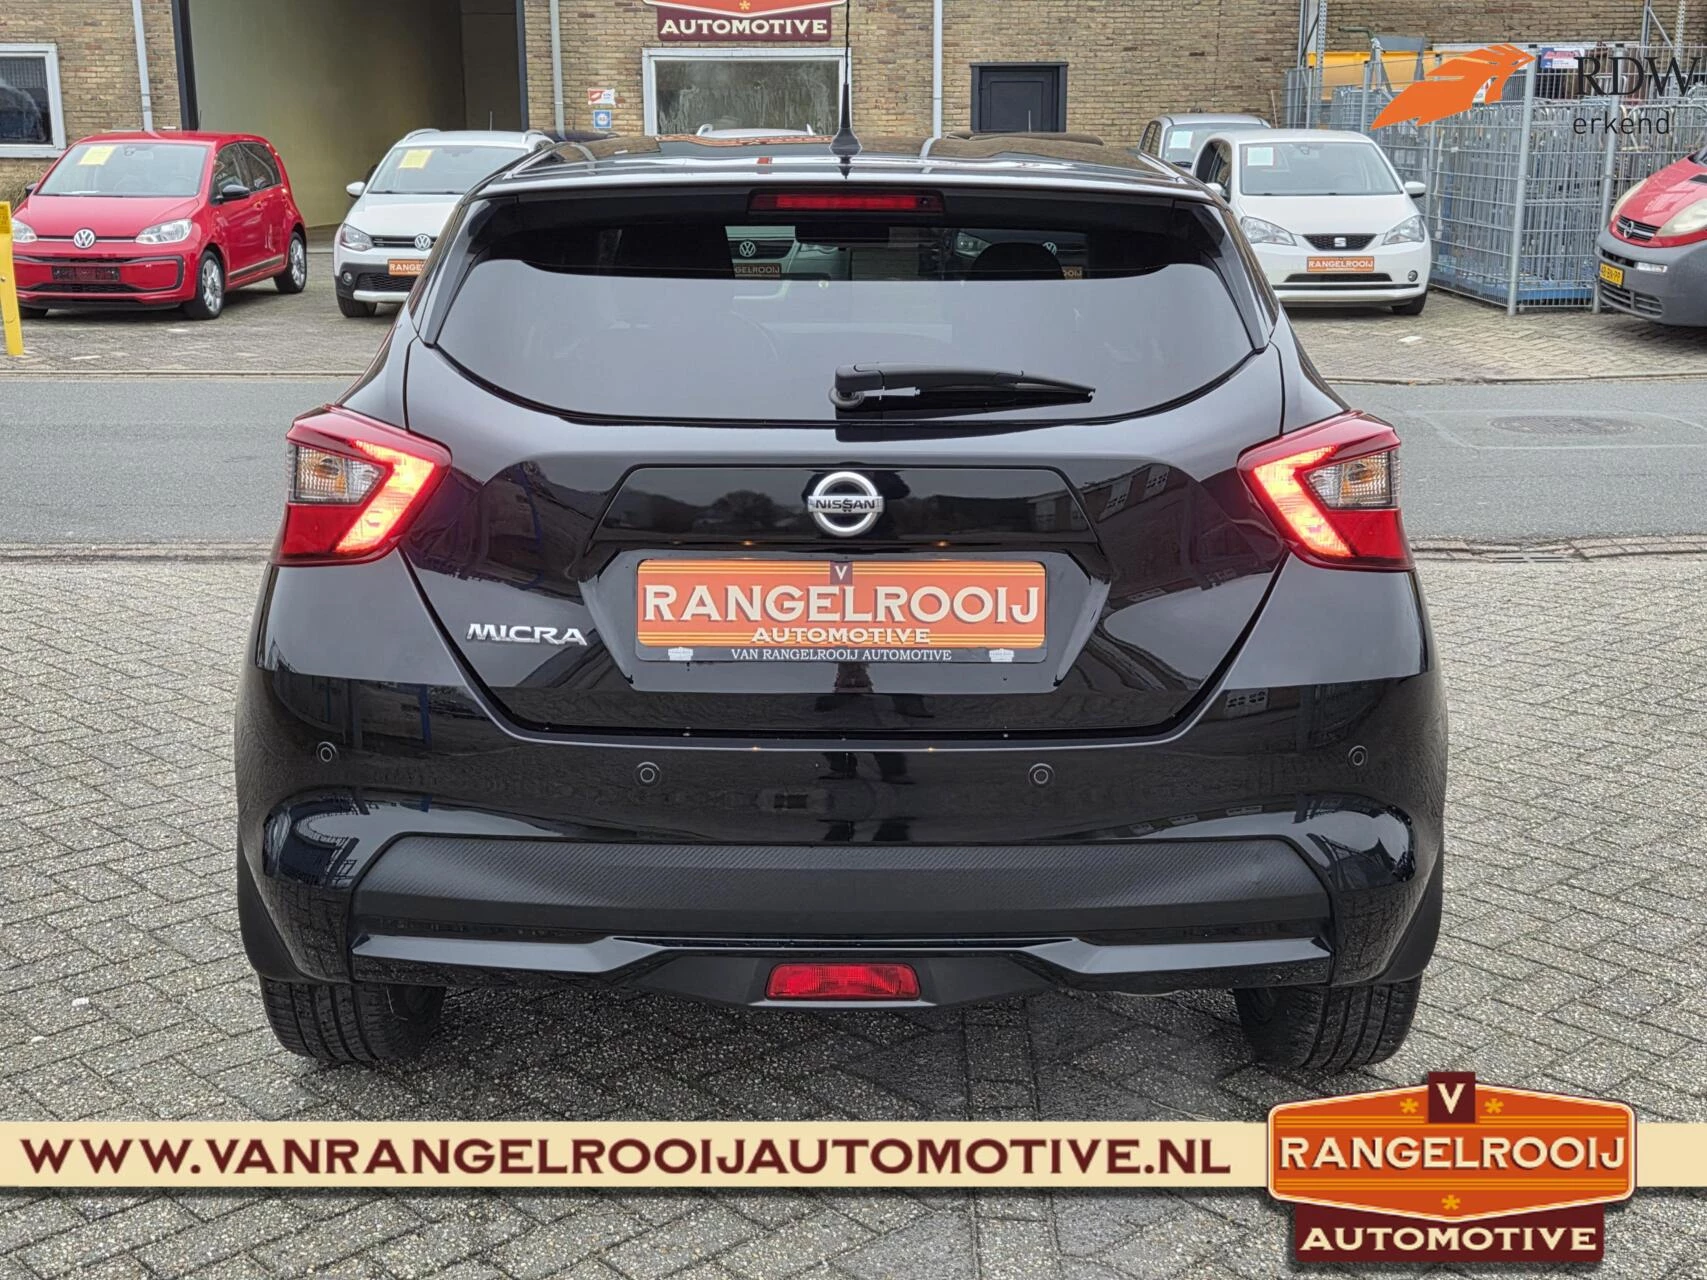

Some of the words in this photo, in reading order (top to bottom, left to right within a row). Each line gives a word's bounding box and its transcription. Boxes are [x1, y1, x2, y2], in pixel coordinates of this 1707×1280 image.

[660, 19, 828, 35] AUTOMOTIVE
[1308, 260, 1373, 268] RANGELROOIJ
[815, 499, 876, 510] NISSAN
[835, 565, 848, 581] V
[643, 584, 1040, 623] RANGELROOIJ
[466, 623, 588, 646] MICRA
[751, 627, 931, 645] AUTOMOTIVE
[731, 648, 759, 661] VAN
[763, 648, 858, 661] RANGELROOIJ
[862, 649, 953, 661] AUTOMOTIVE
